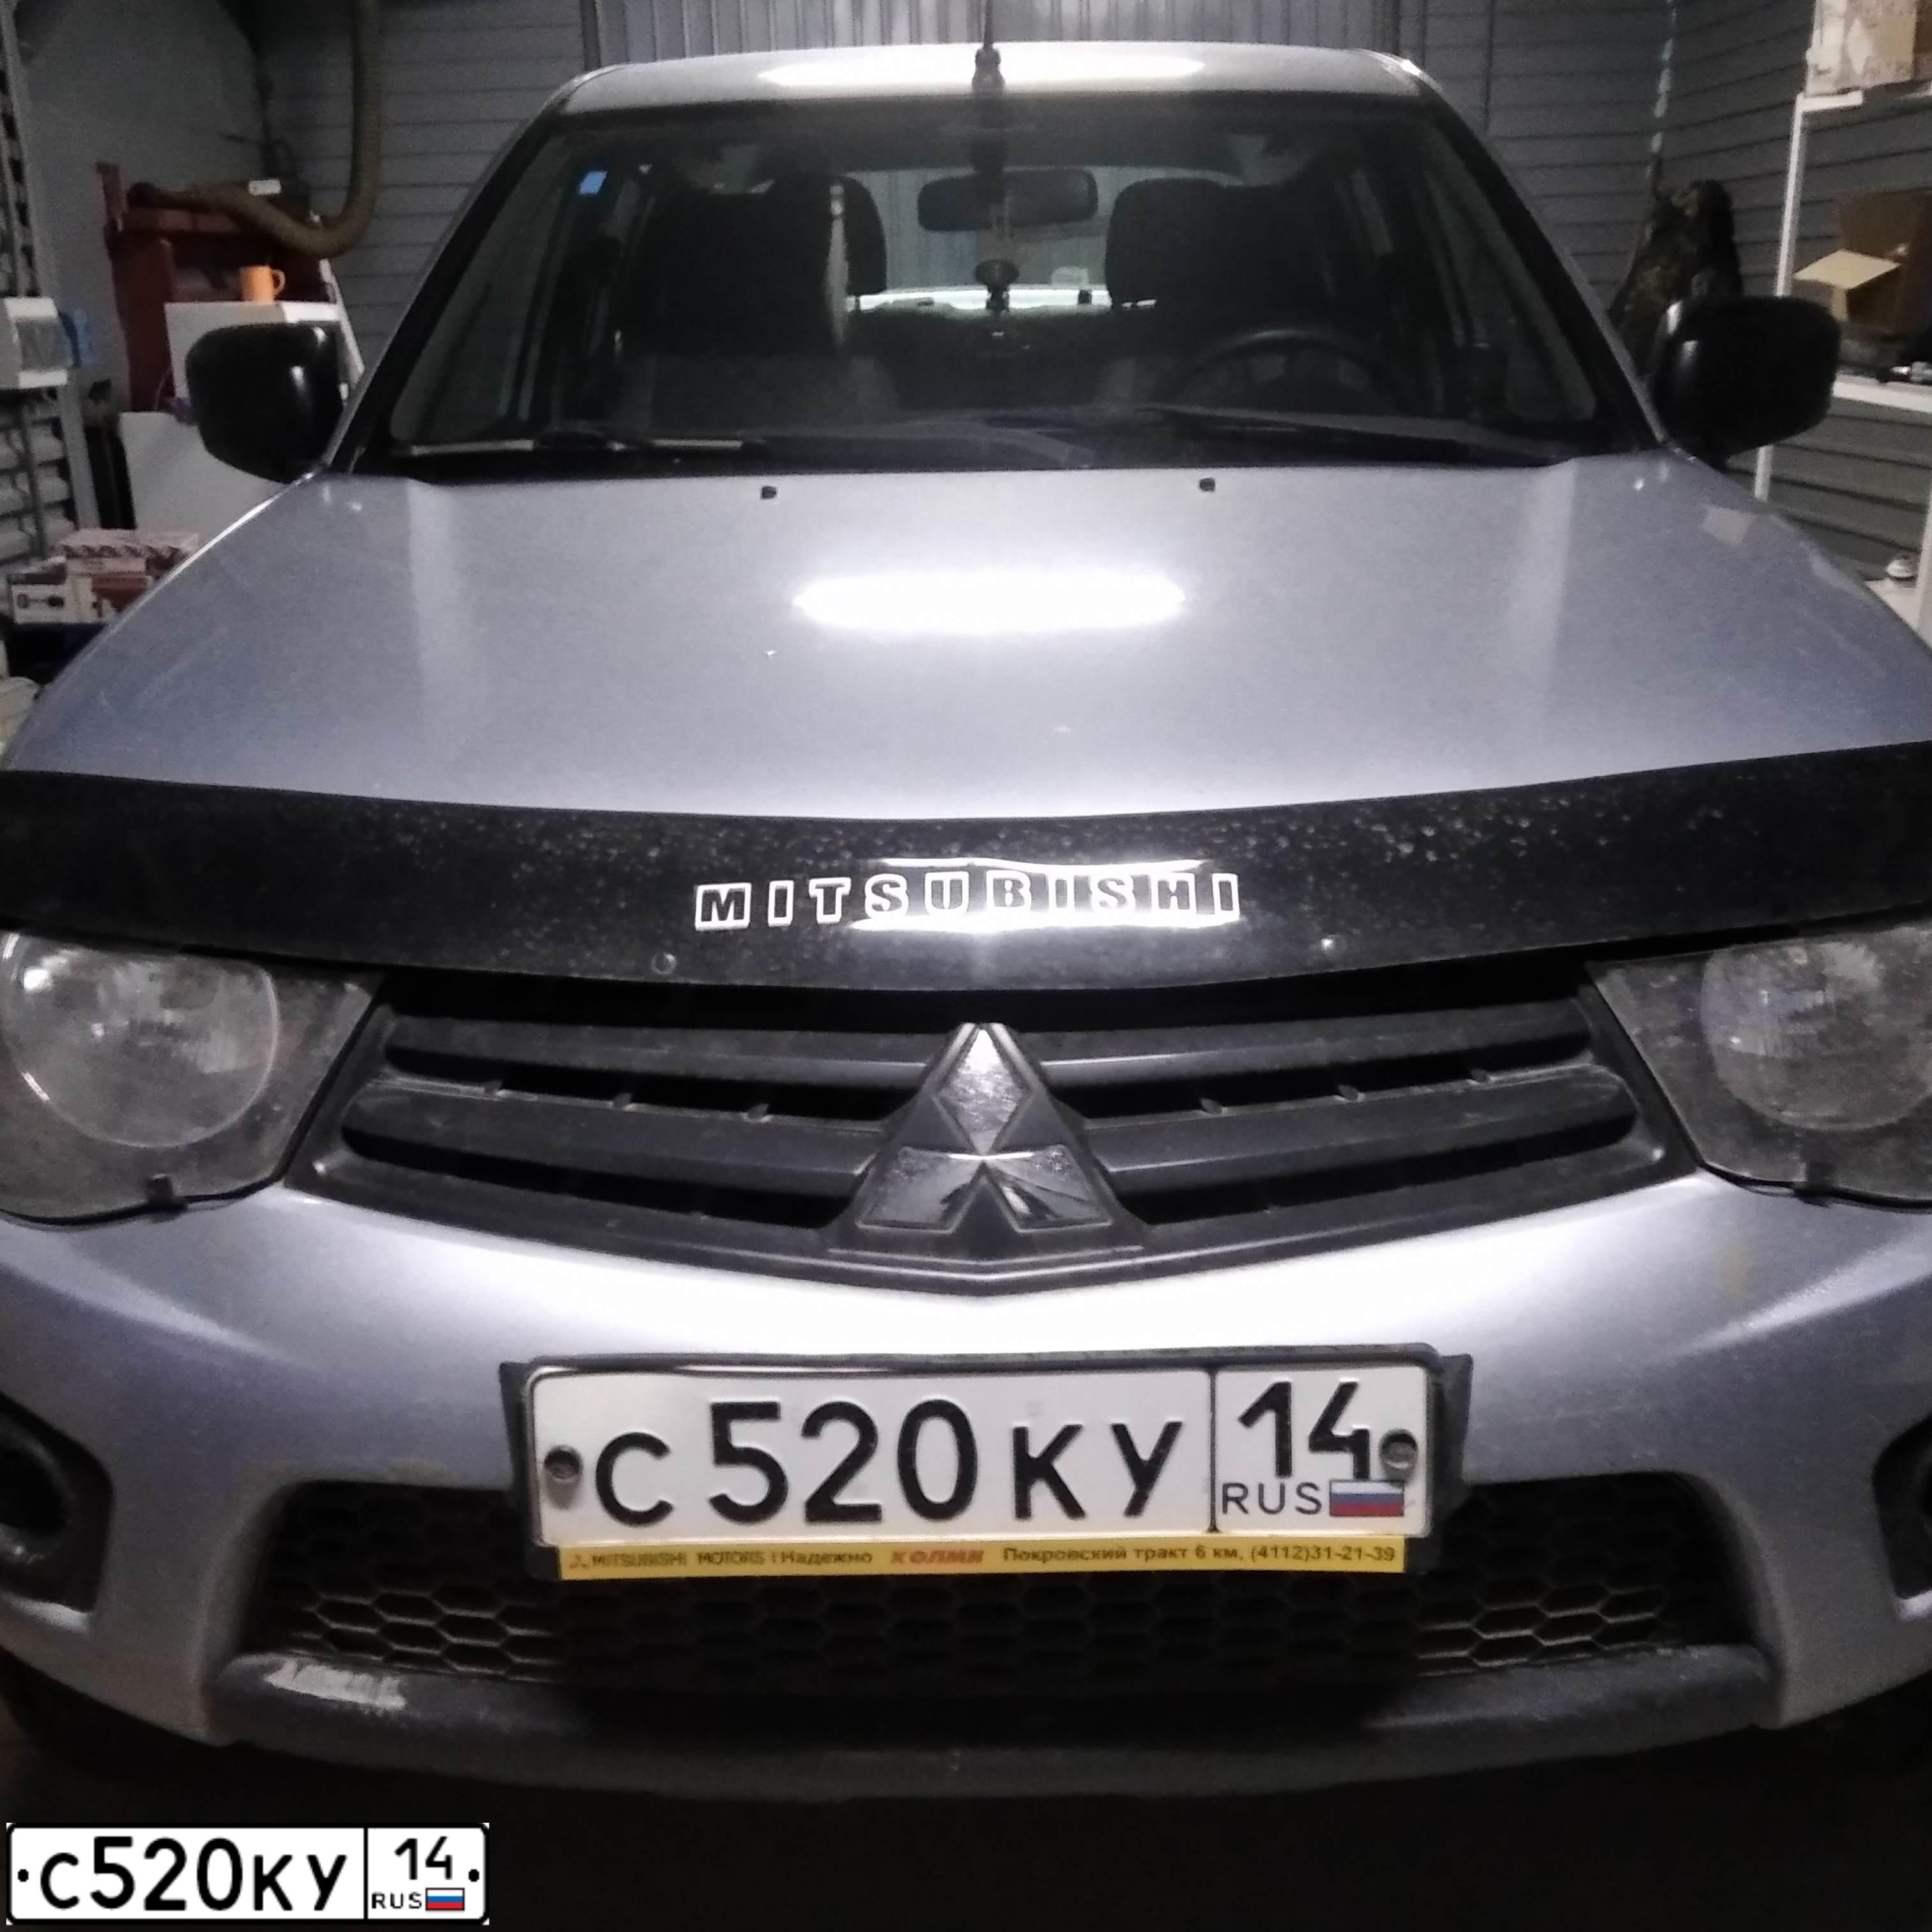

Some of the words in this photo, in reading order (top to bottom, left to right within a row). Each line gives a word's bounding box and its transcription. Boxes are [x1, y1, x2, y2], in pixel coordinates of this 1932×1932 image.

[694, 870, 1240, 931] MITSUBISHI
[1238, 1381, 1371, 1480] 14
[1222, 1482, 1322, 1515] RUS
[697, 1550, 765, 1565] MOTORS
[1002, 1547, 1127, 1564] Покровский
[1134, 1547, 1187, 1563] тракт
[1194, 1544, 1206, 1560] 6
